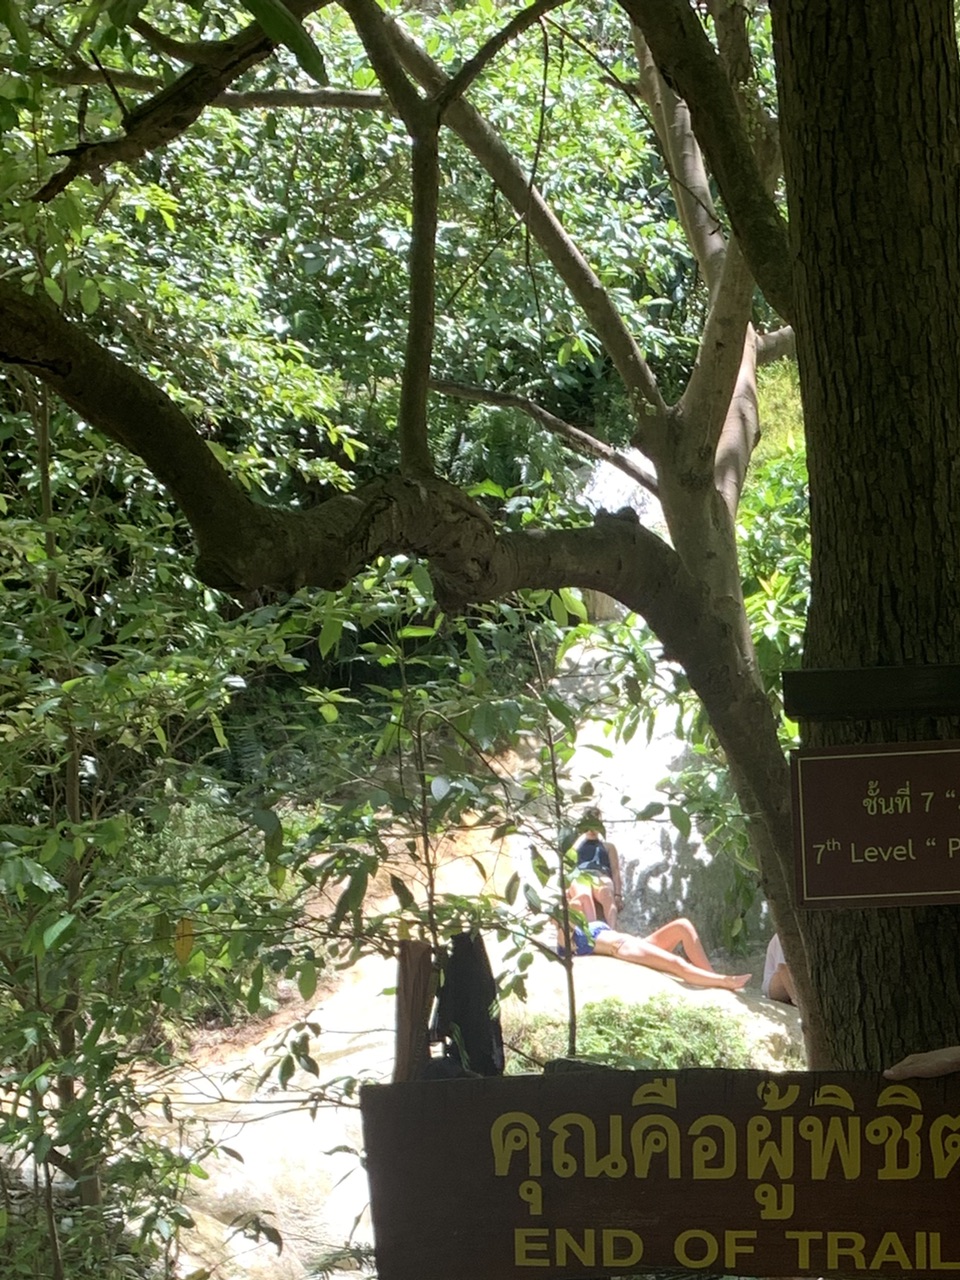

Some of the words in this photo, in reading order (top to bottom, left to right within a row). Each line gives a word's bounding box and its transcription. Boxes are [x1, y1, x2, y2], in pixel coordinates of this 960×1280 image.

[862, 780, 912, 815] ชั้นที่
[920, 791, 935, 813] 7
[812, 837, 841, 865] 7th
[850, 838, 916, 864] Level
[514, 1228, 644, 1268] END
[673, 1229, 758, 1270] OF
